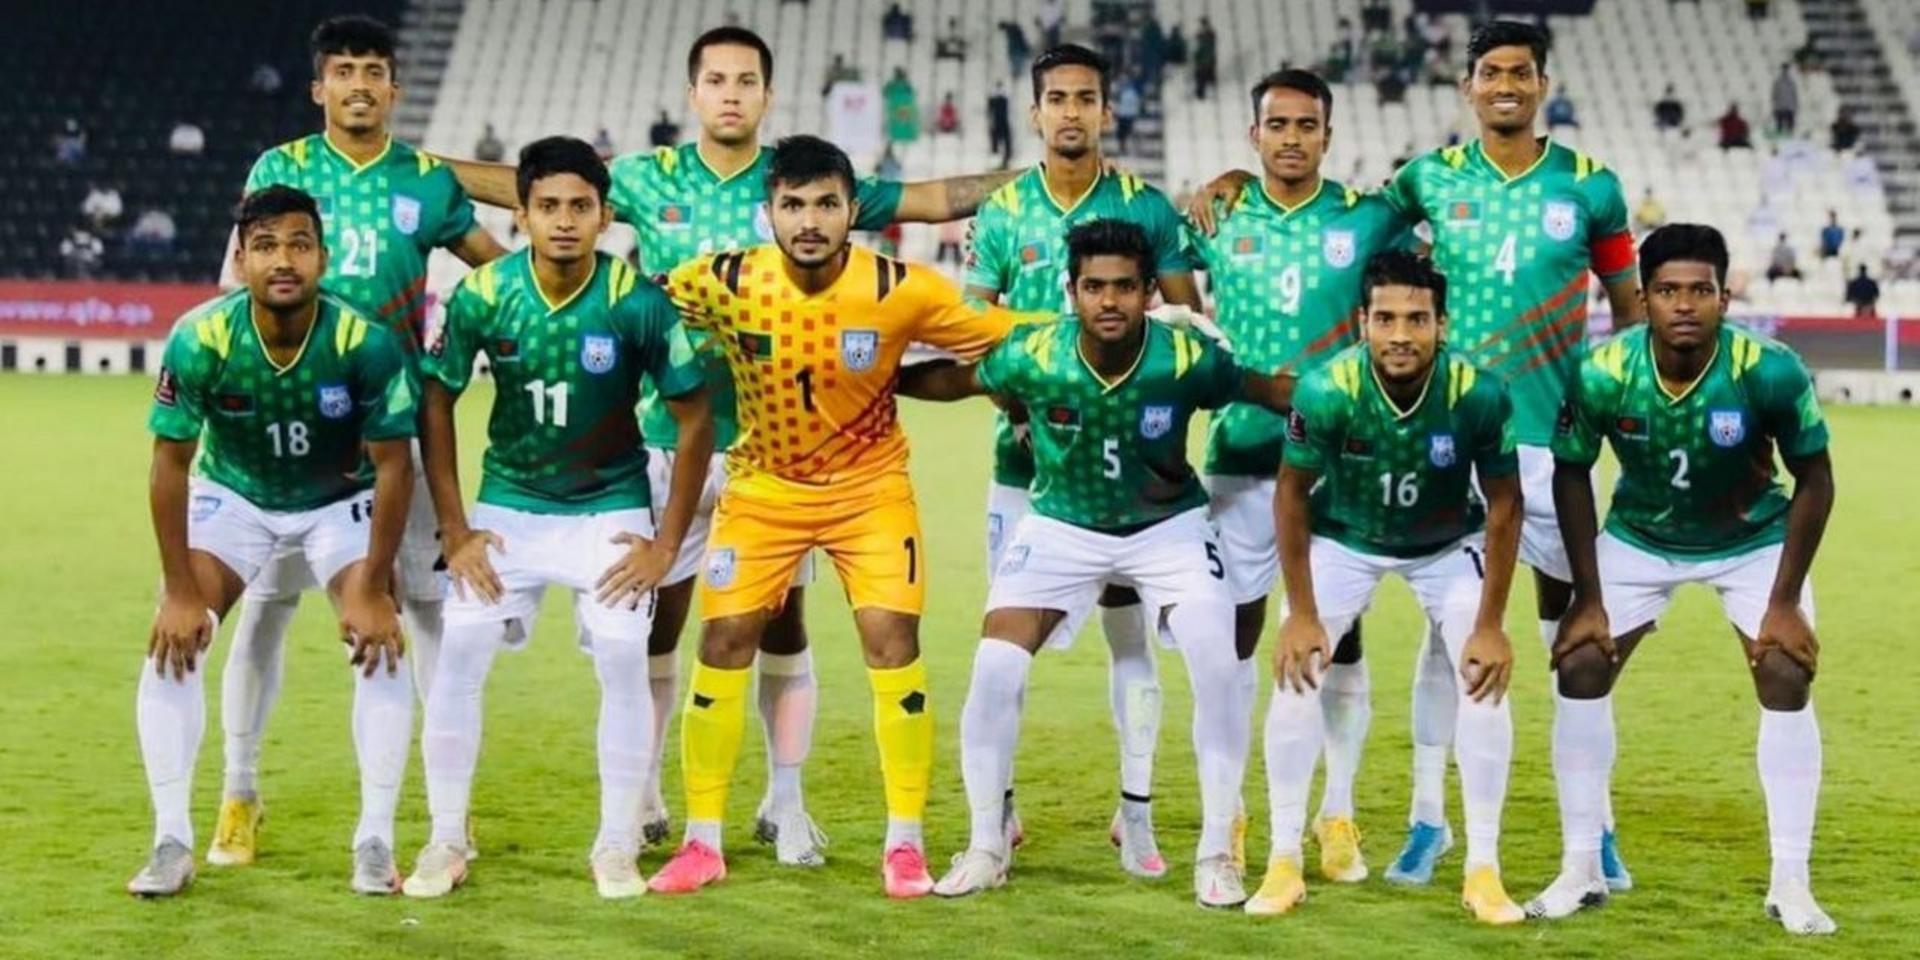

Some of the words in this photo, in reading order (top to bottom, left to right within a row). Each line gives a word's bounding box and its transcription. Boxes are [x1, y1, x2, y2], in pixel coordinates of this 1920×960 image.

[341, 228, 377, 276] 21
[1494, 231, 1516, 286] 4
[1281, 262, 1300, 315] 9
[524, 379, 568, 427] 11
[795, 365, 816, 413] 1
[266, 421, 310, 457] 18
[1103, 438, 1121, 479] 5
[1380, 471, 1418, 507] 16
[1669, 449, 1690, 488] 2
[904, 537, 915, 584] 1
[1205, 541, 1224, 579] 5
